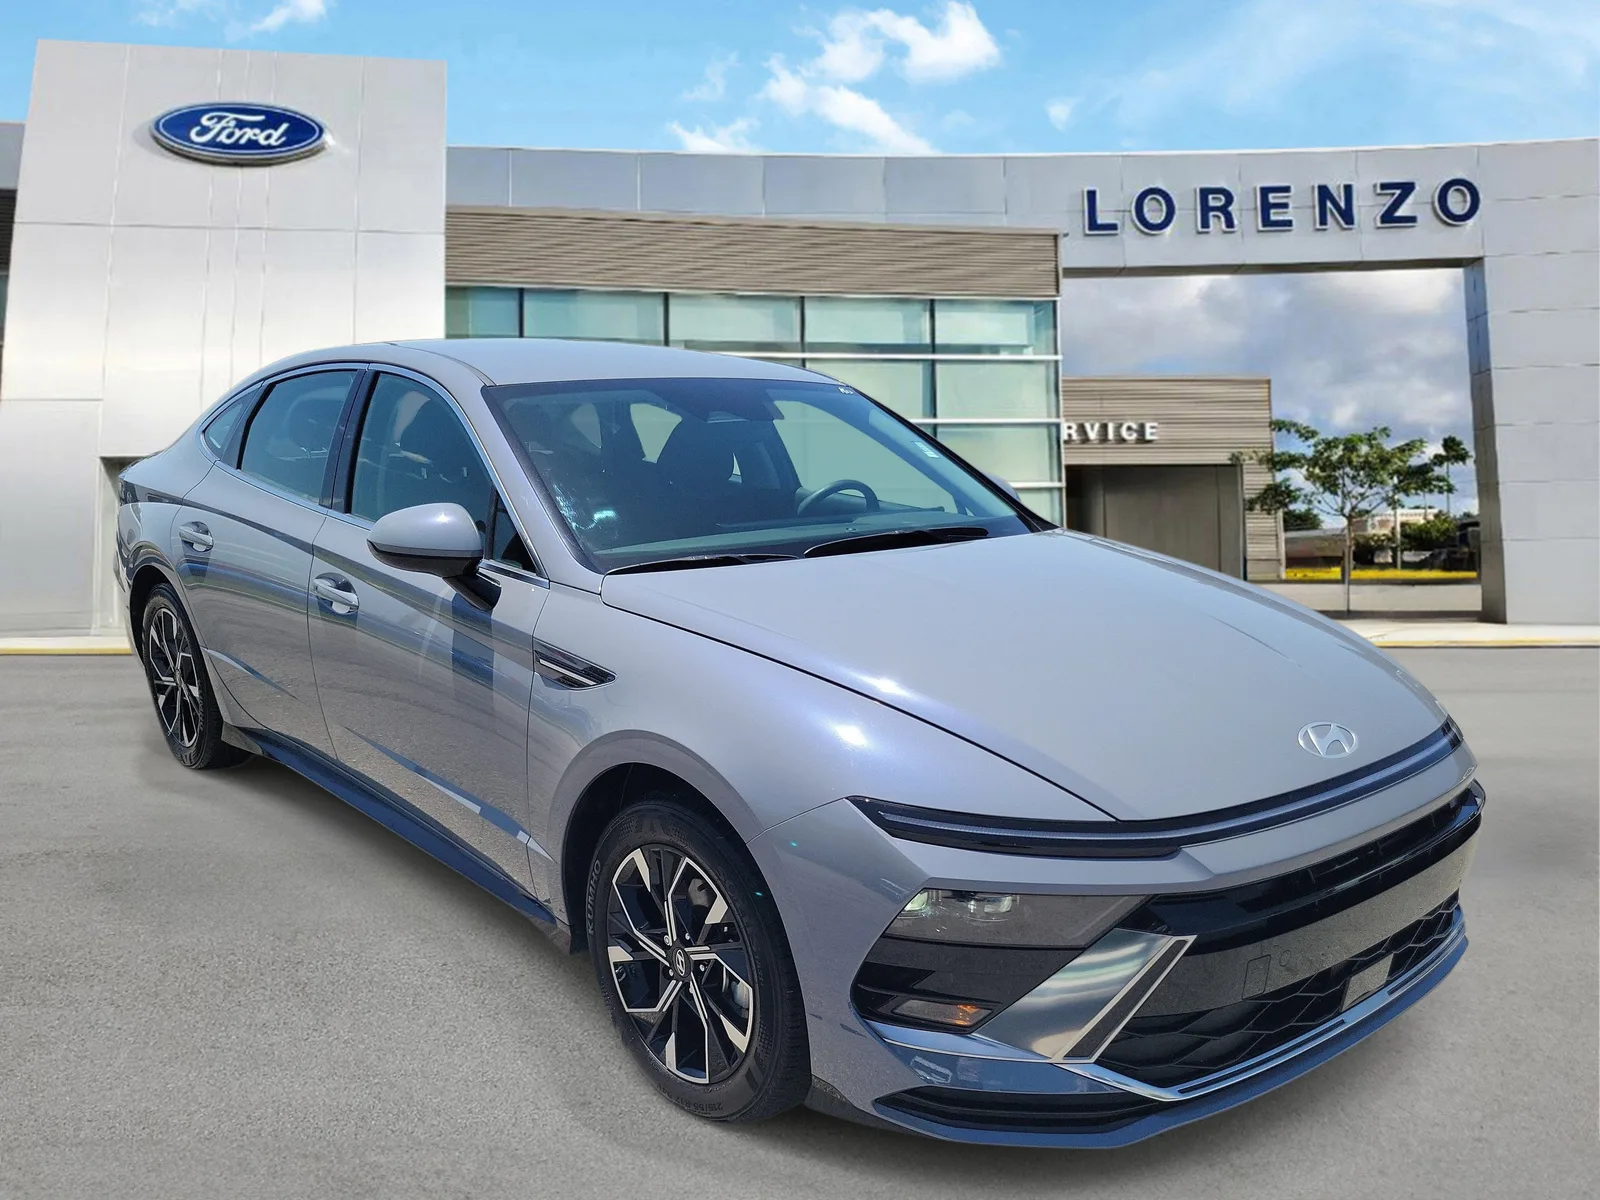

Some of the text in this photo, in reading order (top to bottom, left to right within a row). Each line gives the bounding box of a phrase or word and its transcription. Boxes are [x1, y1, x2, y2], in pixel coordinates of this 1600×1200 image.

[190, 112, 289, 146] Ford
[1083, 178, 1481, 235] LORENZO
[587, 859, 601, 935] KUMHO
